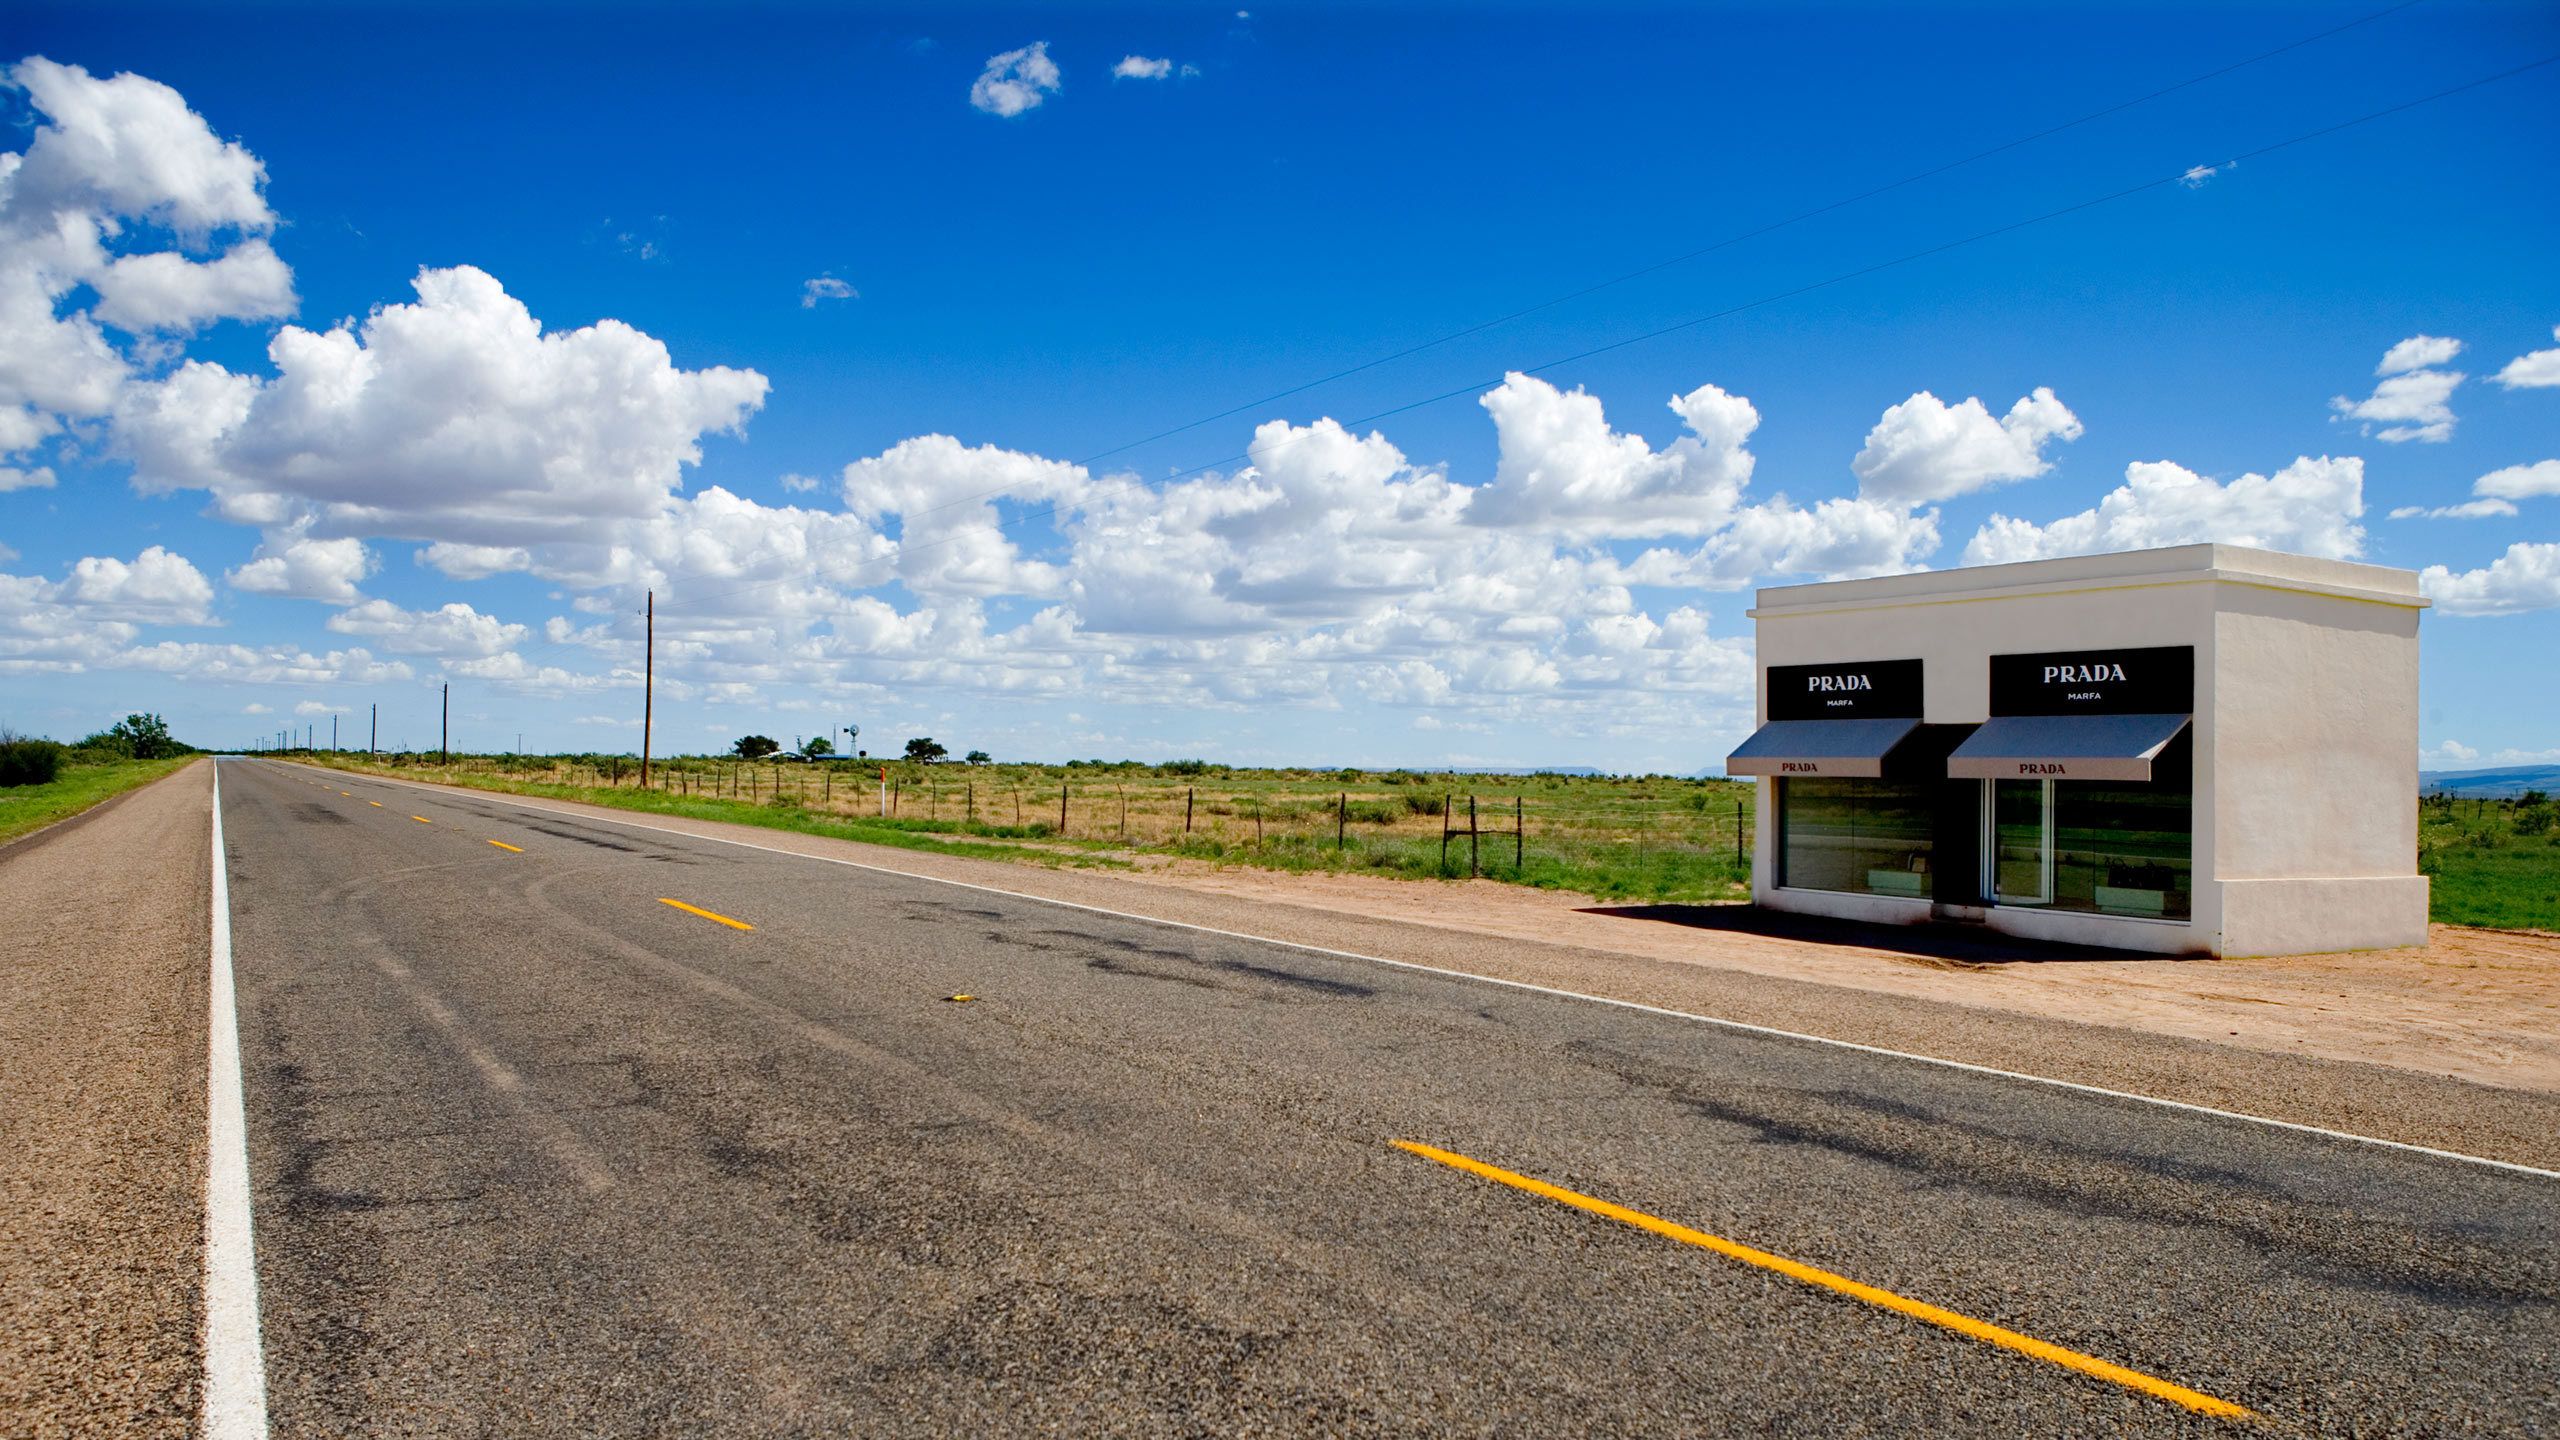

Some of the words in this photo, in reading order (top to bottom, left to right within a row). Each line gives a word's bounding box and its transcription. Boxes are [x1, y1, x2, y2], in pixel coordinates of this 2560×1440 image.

[2043, 664, 2127, 684] PRADA
[1808, 674, 1872, 692] PRADA
[2067, 692, 2102, 700] MARFA
[1826, 699, 1854, 707] MARFA
[1782, 762, 1818, 773] PRADA
[2019, 763, 2066, 775] PRADA
